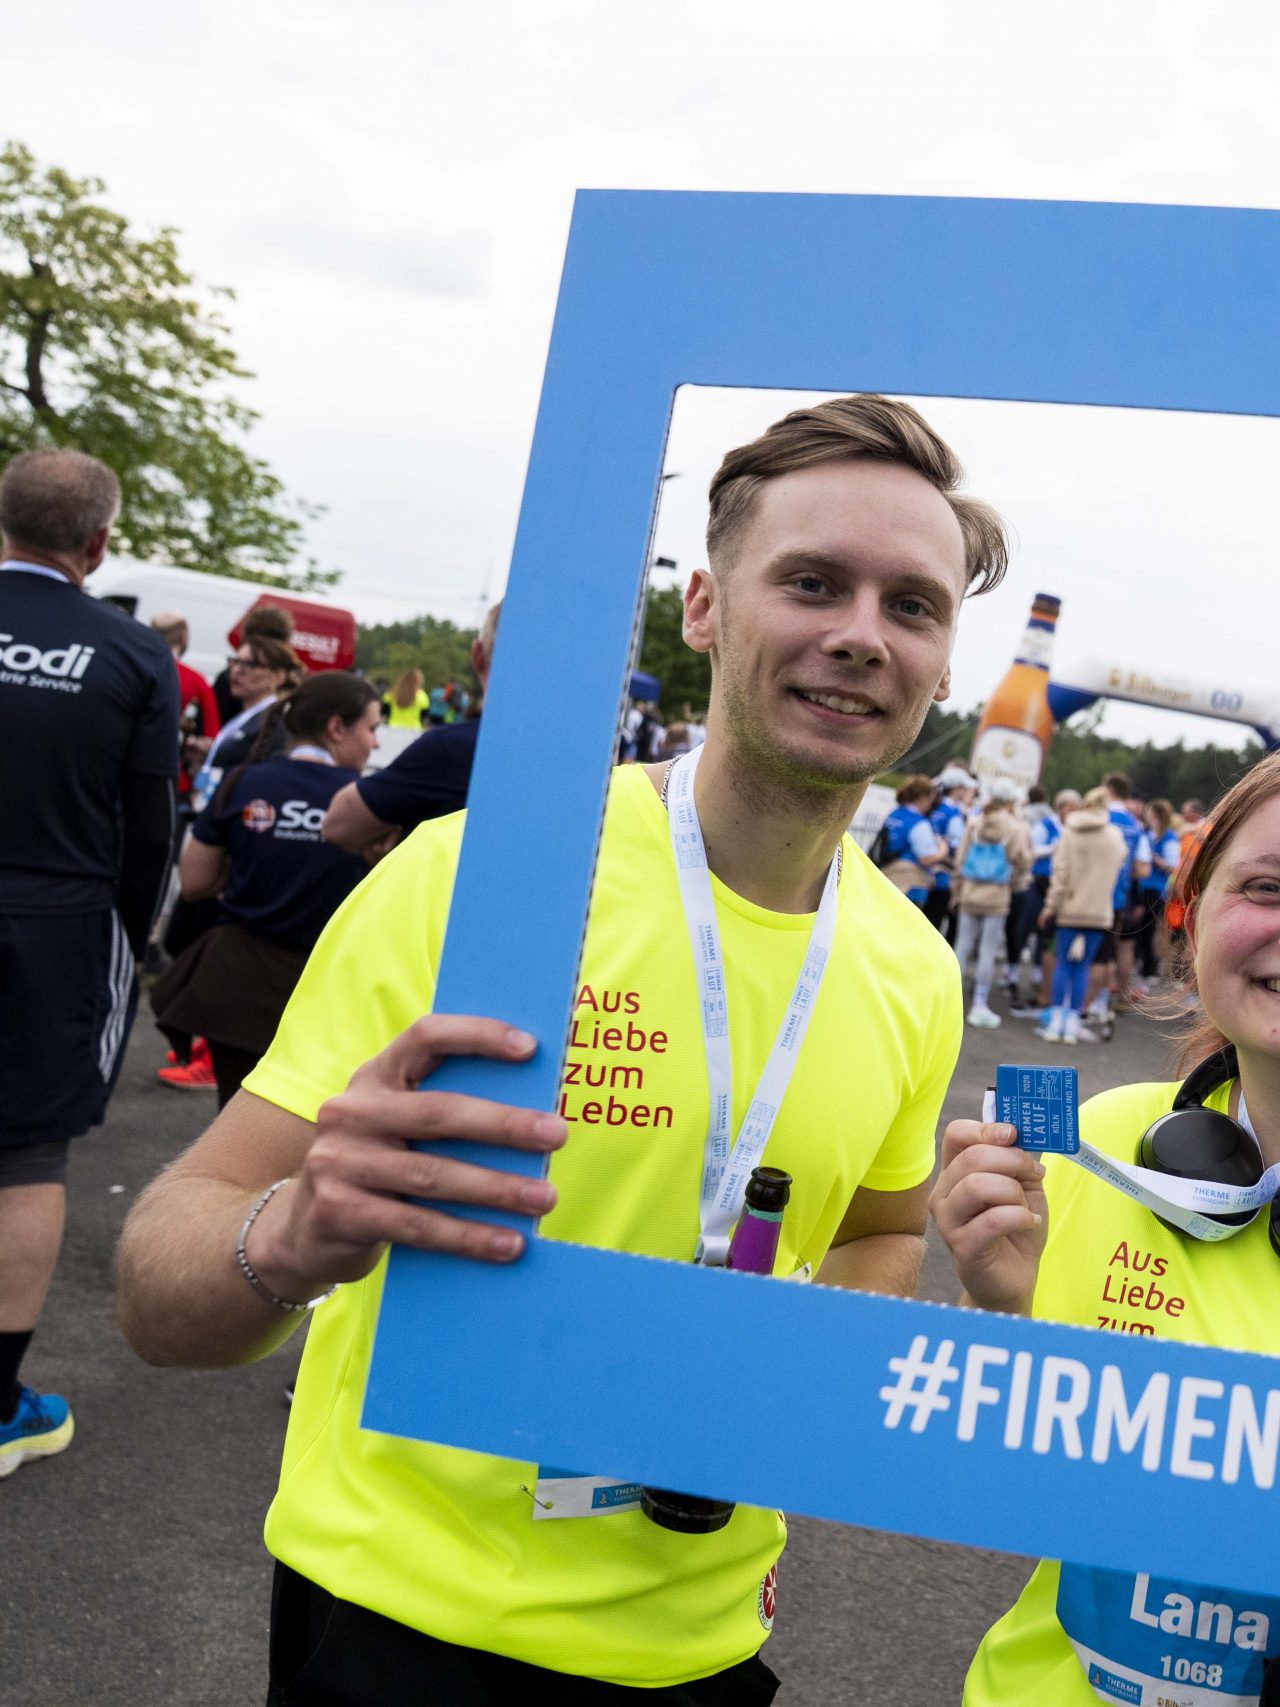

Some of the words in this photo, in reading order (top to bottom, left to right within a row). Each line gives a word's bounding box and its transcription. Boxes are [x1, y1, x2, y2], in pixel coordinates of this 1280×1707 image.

[277, 800, 327, 832] So
[704, 924, 717, 962] THERME
[706, 969, 717, 992] LAUF
[574, 984, 641, 1015] Aus
[799, 988, 811, 1009] LAUF
[570, 1020, 669, 1054] Liebe
[781, 1013, 798, 1048] THERME
[563, 1062, 643, 1090] zum
[559, 1092, 674, 1128] Leben
[1002, 1095, 1011, 1123] RME
[1022, 1101, 1032, 1144] FIRMEN
[1033, 1103, 1046, 1144] LAUF
[1052, 1114, 1060, 1134] KÖLN
[1065, 1106, 1074, 1151] GEMEINSAM
[740, 1144, 754, 1168] LAUF
[719, 1172, 739, 1208] THERME
[1195, 1187, 1231, 1201] THERME
[1108, 1241, 1169, 1276] Aus
[1102, 1275, 1185, 1317] Liebe
[1130, 1571, 1270, 1652] Lana
[1106, 1675, 1139, 1696] THERME
[1160, 1654, 1224, 1688] 1068
